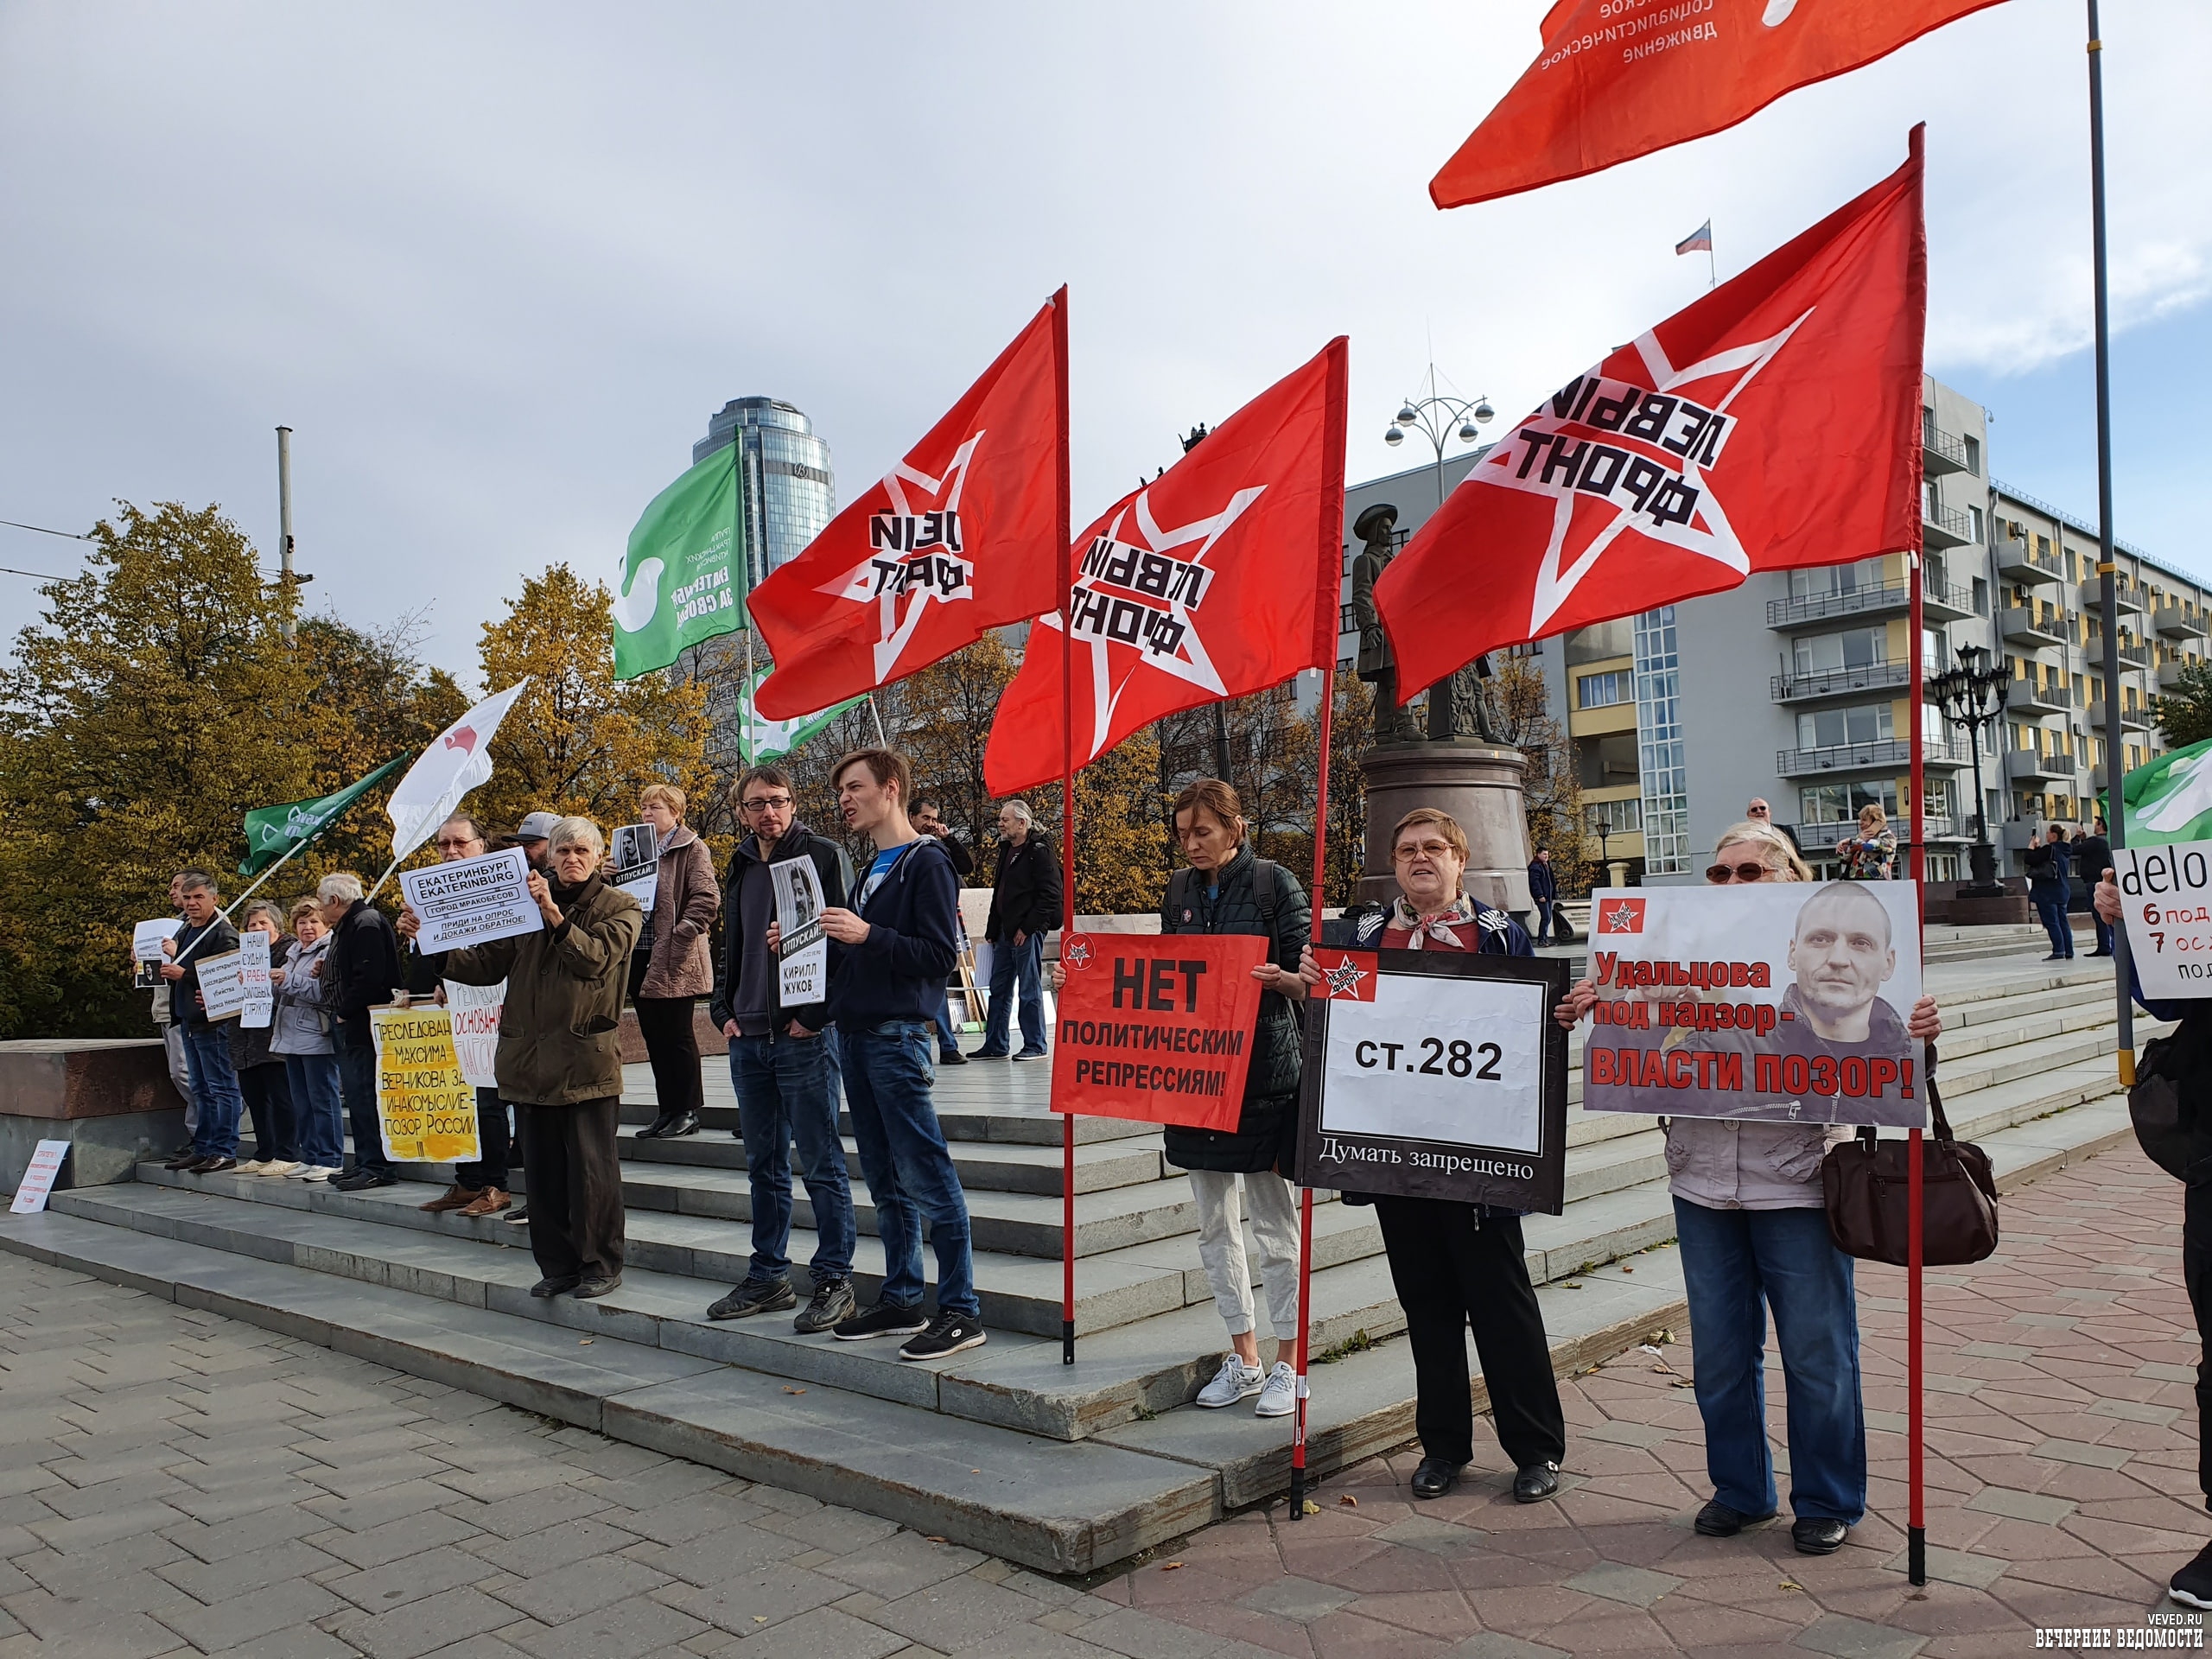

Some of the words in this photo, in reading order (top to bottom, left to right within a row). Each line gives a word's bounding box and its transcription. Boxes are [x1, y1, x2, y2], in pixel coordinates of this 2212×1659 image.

[417, 860, 510, 889] ЕКАТЕРИНБУРГ
[420, 871, 514, 899] EKATERINBURG
[615, 864, 653, 883] ОТПУСКАЙ!
[431, 902, 458, 915] ГОРОД
[460, 891, 514, 908] МРАКОБЕСОВ
[2143, 903, 2161, 926] 6
[441, 918, 469, 931] ПРИДИ
[486, 908, 514, 920] ОПРОС
[441, 926, 477, 941] ДОКАЖИ
[479, 915, 526, 931] ОБРАТНОЕ!
[247, 934, 265, 948] НАШИ
[782, 922, 822, 955] ОТПУСКАЙ!
[2149, 931, 2164, 954] 7
[242, 952, 264, 966] СУДЬИ
[199, 967, 216, 976] Требую
[203, 973, 238, 988] расследовани
[247, 969, 267, 982] РАБЫ
[784, 963, 817, 981] КИРИЛЛ
[1327, 960, 1357, 984] ЛЕВЫЙ
[1332, 971, 1361, 992] ФРОНТ
[1594, 951, 1770, 991] Удальцова
[213, 987, 235, 998] убийства
[784, 979, 812, 996] ЖУКОВ
[1112, 957, 1207, 1013] НЕТ
[1592, 1000, 1650, 1031] под
[1658, 1001, 1777, 1037] надзор
[1062, 1020, 1244, 1056] ПОЛИТИЧЕСКИМ
[394, 1044, 447, 1065] МАКСИМА
[1355, 1038, 1503, 1081] ст.282
[382, 1070, 447, 1090] ВЕРНИКОВА
[452, 1069, 467, 1086] ЗА
[1076, 1058, 1227, 1097] РЕПРЕССИЯМ!
[1591, 1046, 1745, 1092] ВЛАСТИ
[1755, 1053, 1914, 1100] ПОЗОР!
[385, 1118, 422, 1136] ПОЗОР
[1319, 1137, 1402, 1164] Думать
[1408, 1151, 1535, 1180] запрещено
